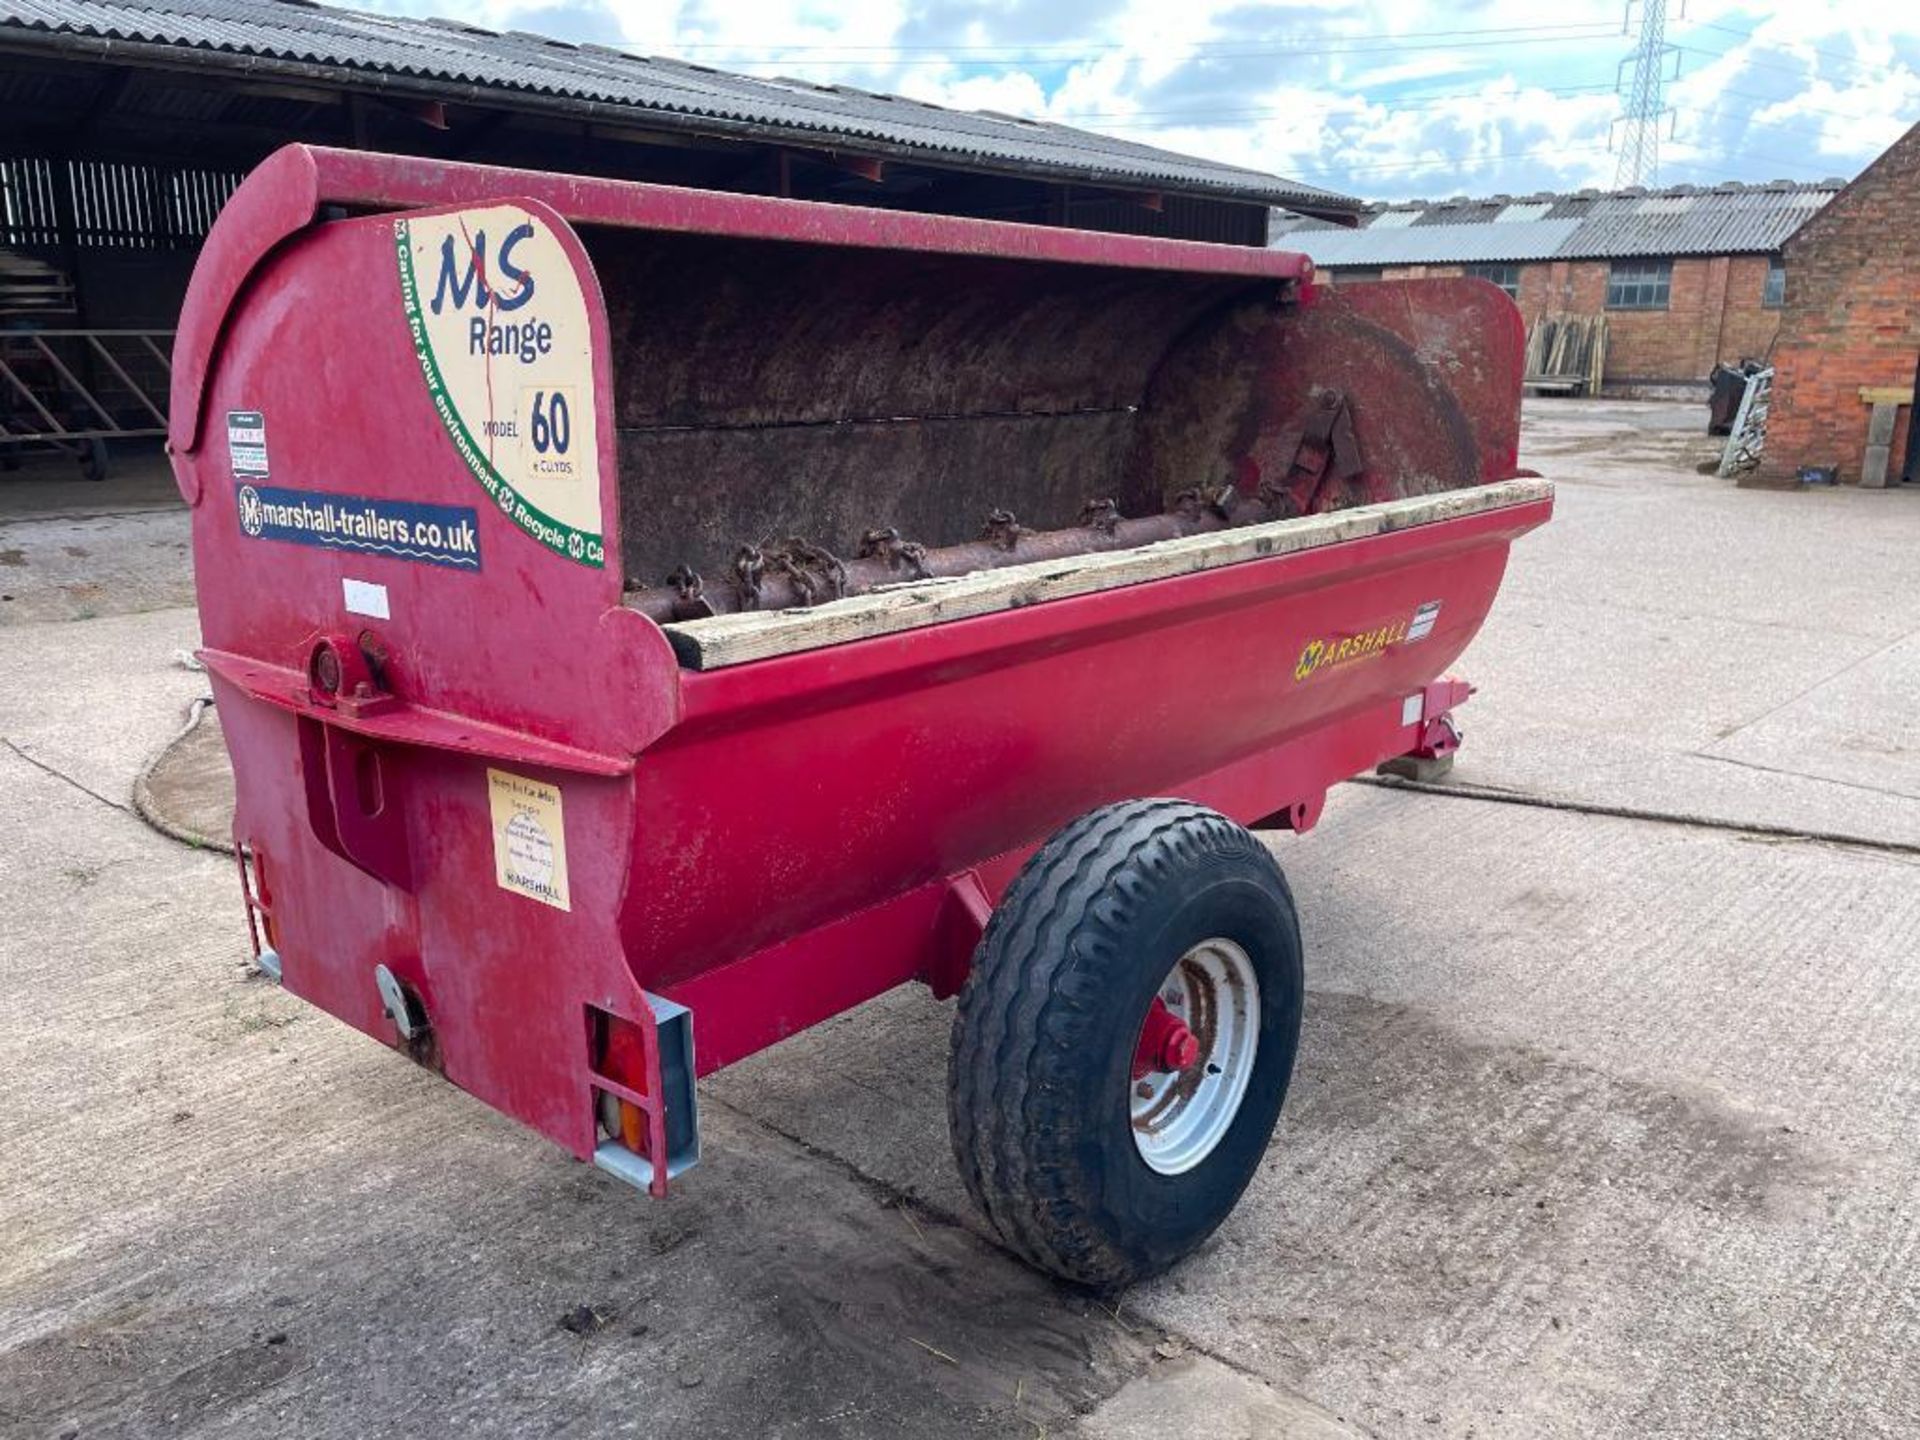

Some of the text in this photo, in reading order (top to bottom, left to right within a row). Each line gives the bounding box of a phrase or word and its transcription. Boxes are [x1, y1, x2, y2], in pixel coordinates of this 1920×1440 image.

[430, 224, 535, 315] MS
[470, 316, 552, 364] Range
[397, 244, 417, 315] Caring
[409, 316, 425, 347] for
[417, 349, 439, 391] your
[436, 394, 499, 495] environment
[515, 503, 565, 548] Recycle
[531, 390, 570, 455] 60
[482, 420, 519, 437] MODEL
[263, 501, 476, 553] marshall-trailers.co.uk
[1295, 621, 1405, 681] MARSHALL
